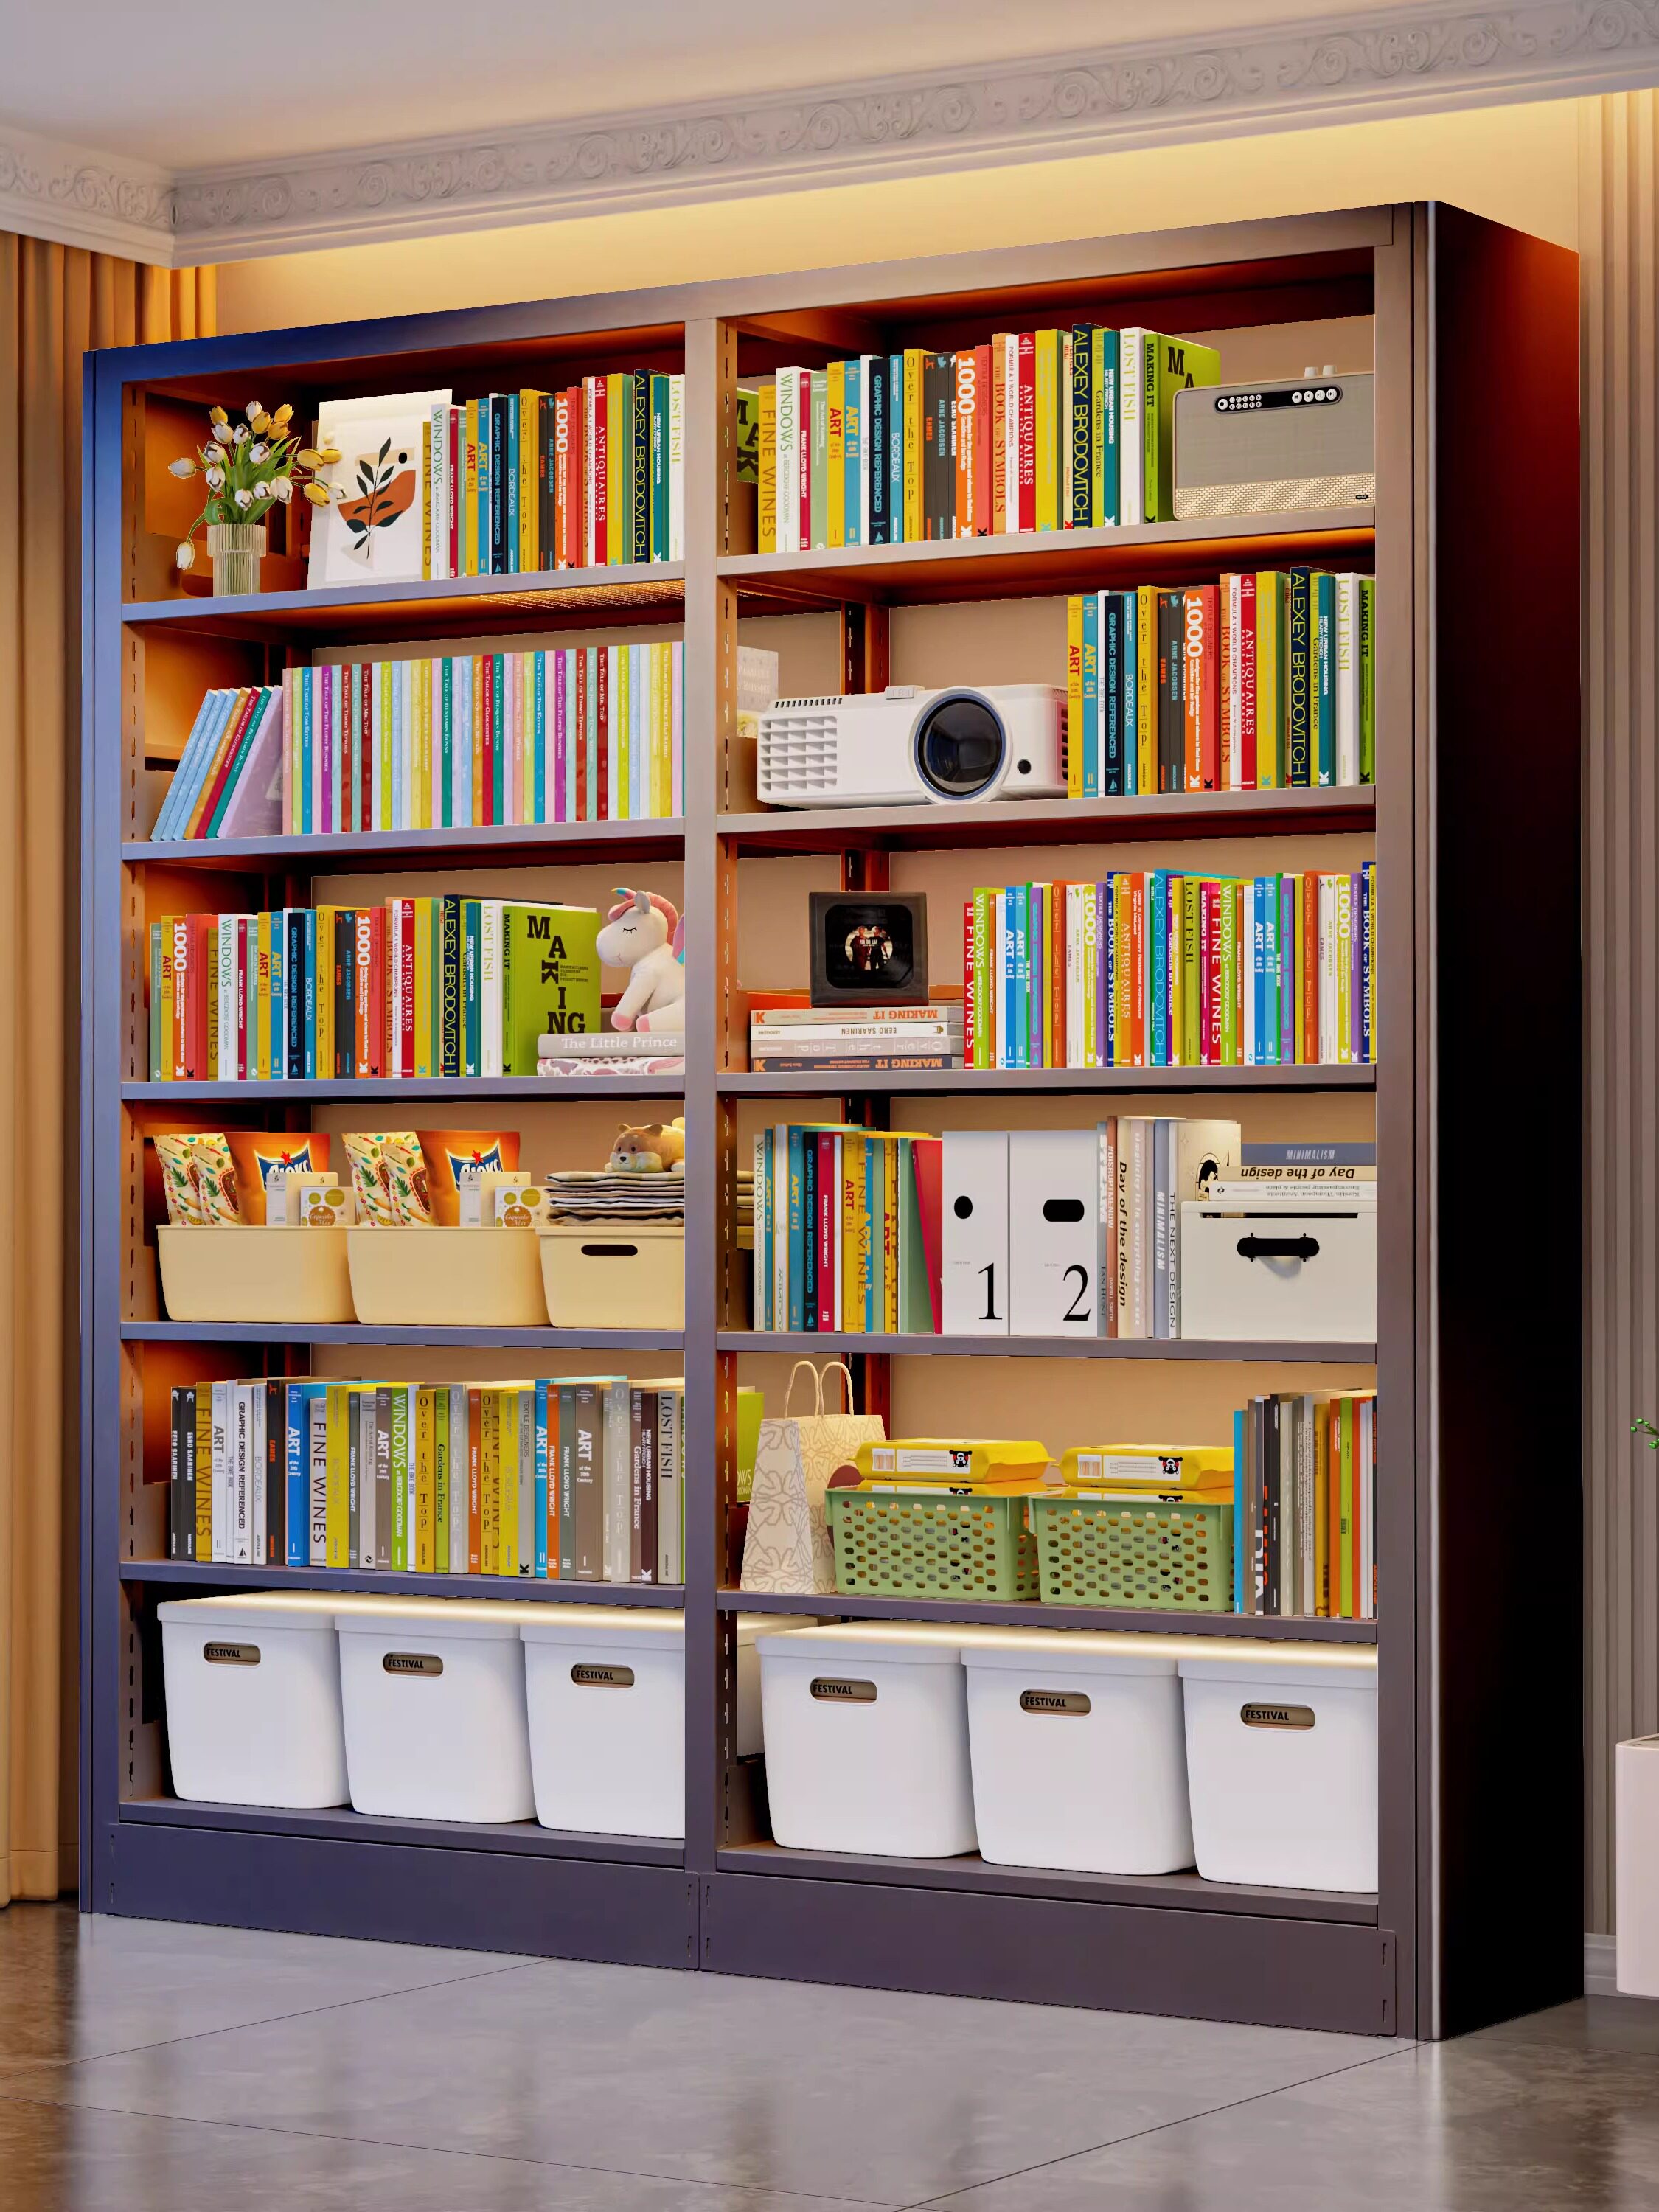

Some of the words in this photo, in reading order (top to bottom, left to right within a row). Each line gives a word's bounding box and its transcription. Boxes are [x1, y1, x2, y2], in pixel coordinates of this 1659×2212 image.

[1074, 330, 1088, 398] ALEXEY
[1124, 334, 1135, 378] LOST
[672, 381, 681, 424] LOST
[958, 357, 975, 414] 1000
[995, 383, 1005, 423] BOOK
[1124, 383, 1135, 420] FISH
[1147, 395, 1154, 406] IT
[557, 398, 568, 453] 1000
[636, 375, 645, 440] ALEXEY
[780, 374, 793, 451] WINDOWS
[830, 408, 841, 437] ART
[846, 406, 858, 435] ART
[434, 410, 442, 484] WINDOWS
[672, 428, 681, 462] FISH
[763, 410, 775, 457] FINE
[1023, 386, 1033, 484] ANTIQUAIRES
[1096, 433, 1103, 441] in
[479, 442, 487, 470] ART
[891, 433, 900, 482] BORDEAUX
[995, 441, 1005, 512] SYMBOLS
[1074, 405, 1088, 520] BRODOVITCH
[636, 447, 645, 555] BRODOVITCH
[763, 467, 775, 537] WINES
[1293, 573, 1305, 645] ALEXEY
[1339, 580, 1349, 625] LOST
[1187, 597, 1203, 657] 1000
[1070, 645, 1079, 675] ART
[1085, 644, 1096, 675] ART
[1339, 633, 1349, 670] FISH
[1361, 645, 1368, 656] IT
[1245, 629, 1254, 734] ANTIQUAIRES
[1293, 653, 1305, 774] BRODOVITCH
[174, 923, 187, 971] 1000
[445, 900, 456, 959] ALEXEY
[976, 894, 984, 967] WINDOWS
[1212, 918, 1220, 964] FINE
[221, 919, 231, 987] WINDOWS
[504, 959, 510, 969] IT
[445, 964, 456, 1065] BRODOVITCH
[874, 1011, 885, 1019] IT
[888, 1010, 938, 1019] MAKING
[1212, 975, 1220, 1044] WINES
[562, 1038, 585, 1048] The
[591, 1037, 628, 1048] Little
[633, 1037, 677, 1048] Prince
[891, 1058, 942, 1068] MAKING
[876, 1059, 888, 1068] IT
[1241, 1169, 1282, 1179] design
[1286, 1150, 1335, 1160] MINIMALISM
[1287, 1169, 1307, 1179] the
[1312, 1169, 1326, 1179] of
[1329, 1169, 1354, 1179] Day
[846, 1180, 854, 1210] ART
[1119, 1162, 1127, 1192] Day
[1119, 1198, 1127, 1217] of
[1157, 1192, 1165, 1270] MINIMALISM
[978, 1263, 1003, 1320] 1
[1063, 1265, 1091, 1321] 2
[1119, 1252, 1127, 1306] design
[393, 1394, 406, 1467] WINDOWS
[661, 1396, 672, 1438] LOST
[288, 1427, 300, 1455] ART
[313, 1422, 326, 1467] FINE
[578, 1430, 591, 1461] ART
[661, 1443, 672, 1478] FISH
[313, 1477, 326, 1543] WINES
[206, 1648, 240, 1658] FESTIVAL
[388, 1658, 424, 1669] FESTIVAL
[577, 1669, 613, 1681] FESTIVAL
[813, 1684, 852, 1695] FESTIVAL
[1025, 1696, 1066, 1708] FESTIVAL
[1245, 1710, 1289, 1722] FESTIVAL
